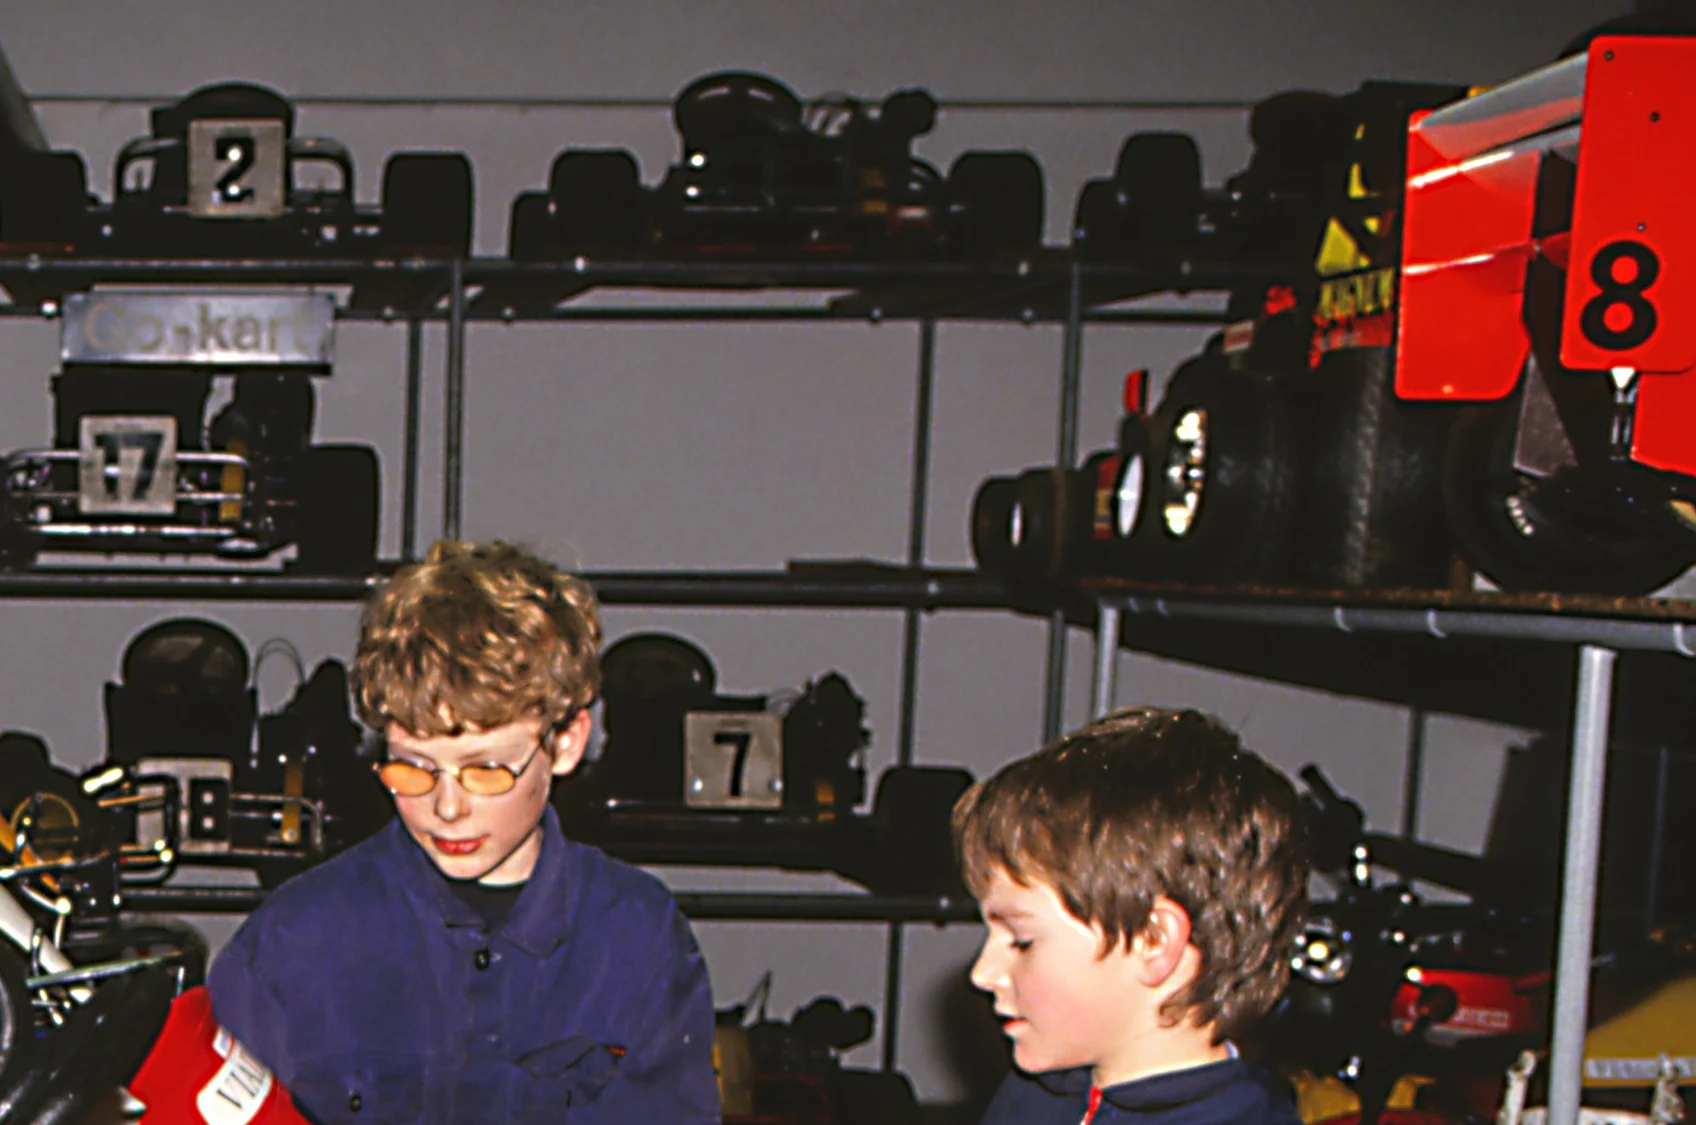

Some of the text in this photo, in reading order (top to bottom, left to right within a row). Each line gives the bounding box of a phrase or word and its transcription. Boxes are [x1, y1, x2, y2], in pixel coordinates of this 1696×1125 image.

[215, 137, 255, 203] 2
[83, 301, 311, 353] Go-kart
[1580, 239, 1660, 351] 8
[93, 432, 165, 501] 17
[713, 731, 751, 798] 7
